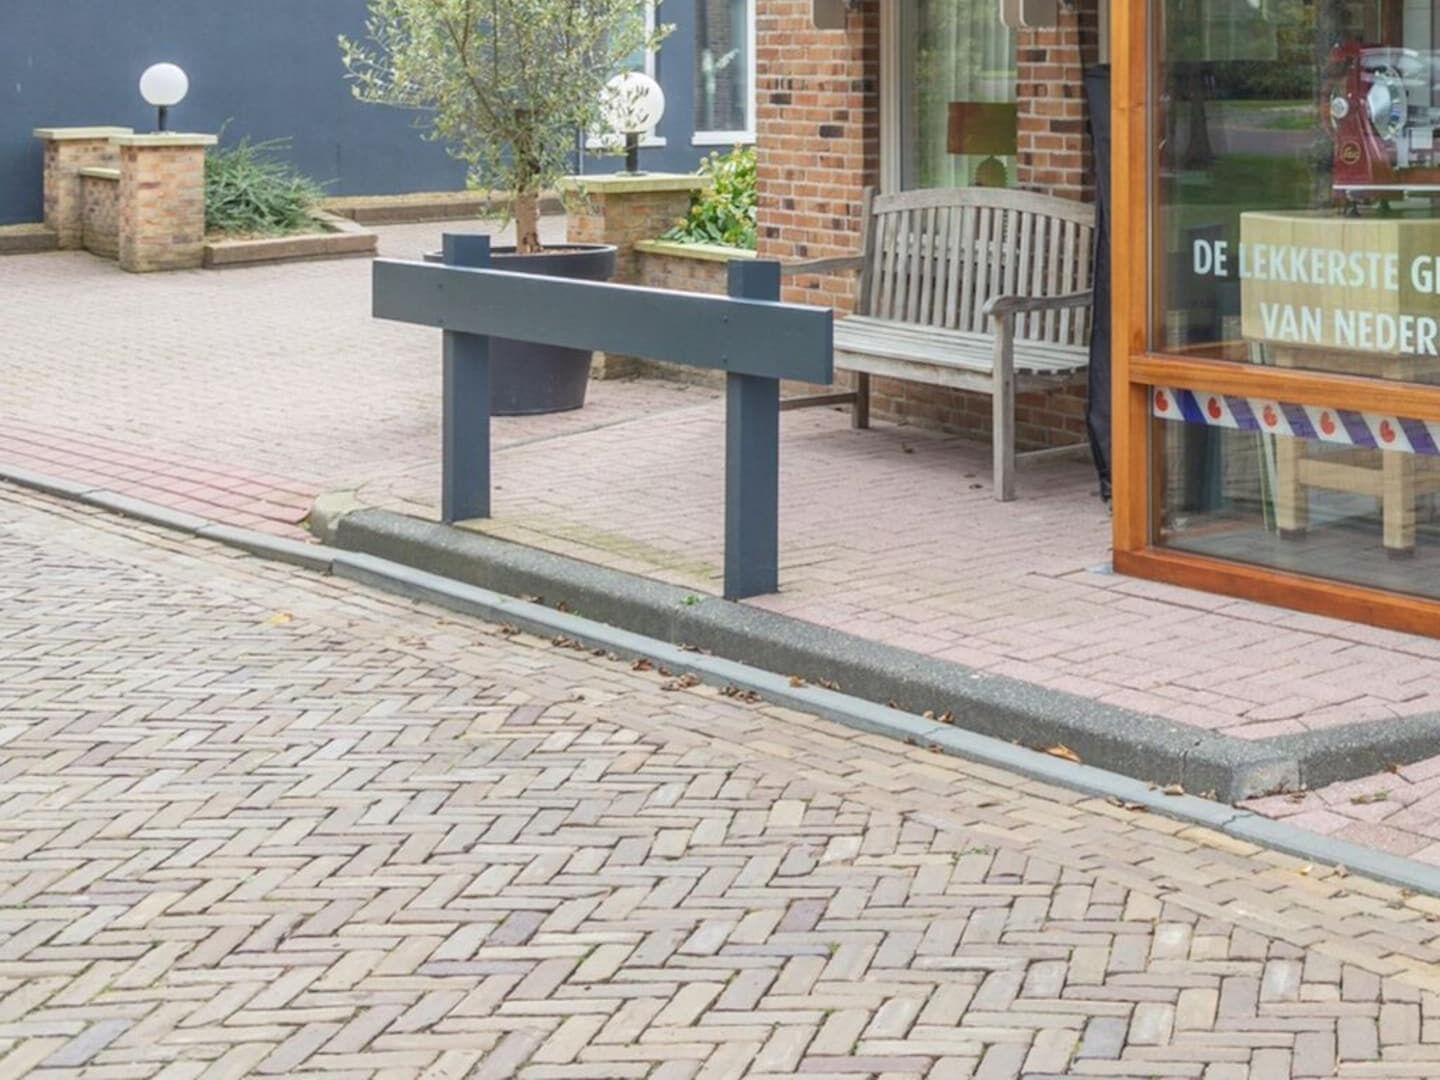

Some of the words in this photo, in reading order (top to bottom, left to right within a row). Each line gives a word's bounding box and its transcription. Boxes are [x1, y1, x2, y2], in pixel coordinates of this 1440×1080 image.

[1193, 239, 1228, 277] DE
[1239, 241, 1399, 291] LEKKERSTE
[1260, 302, 1323, 345] VAN
